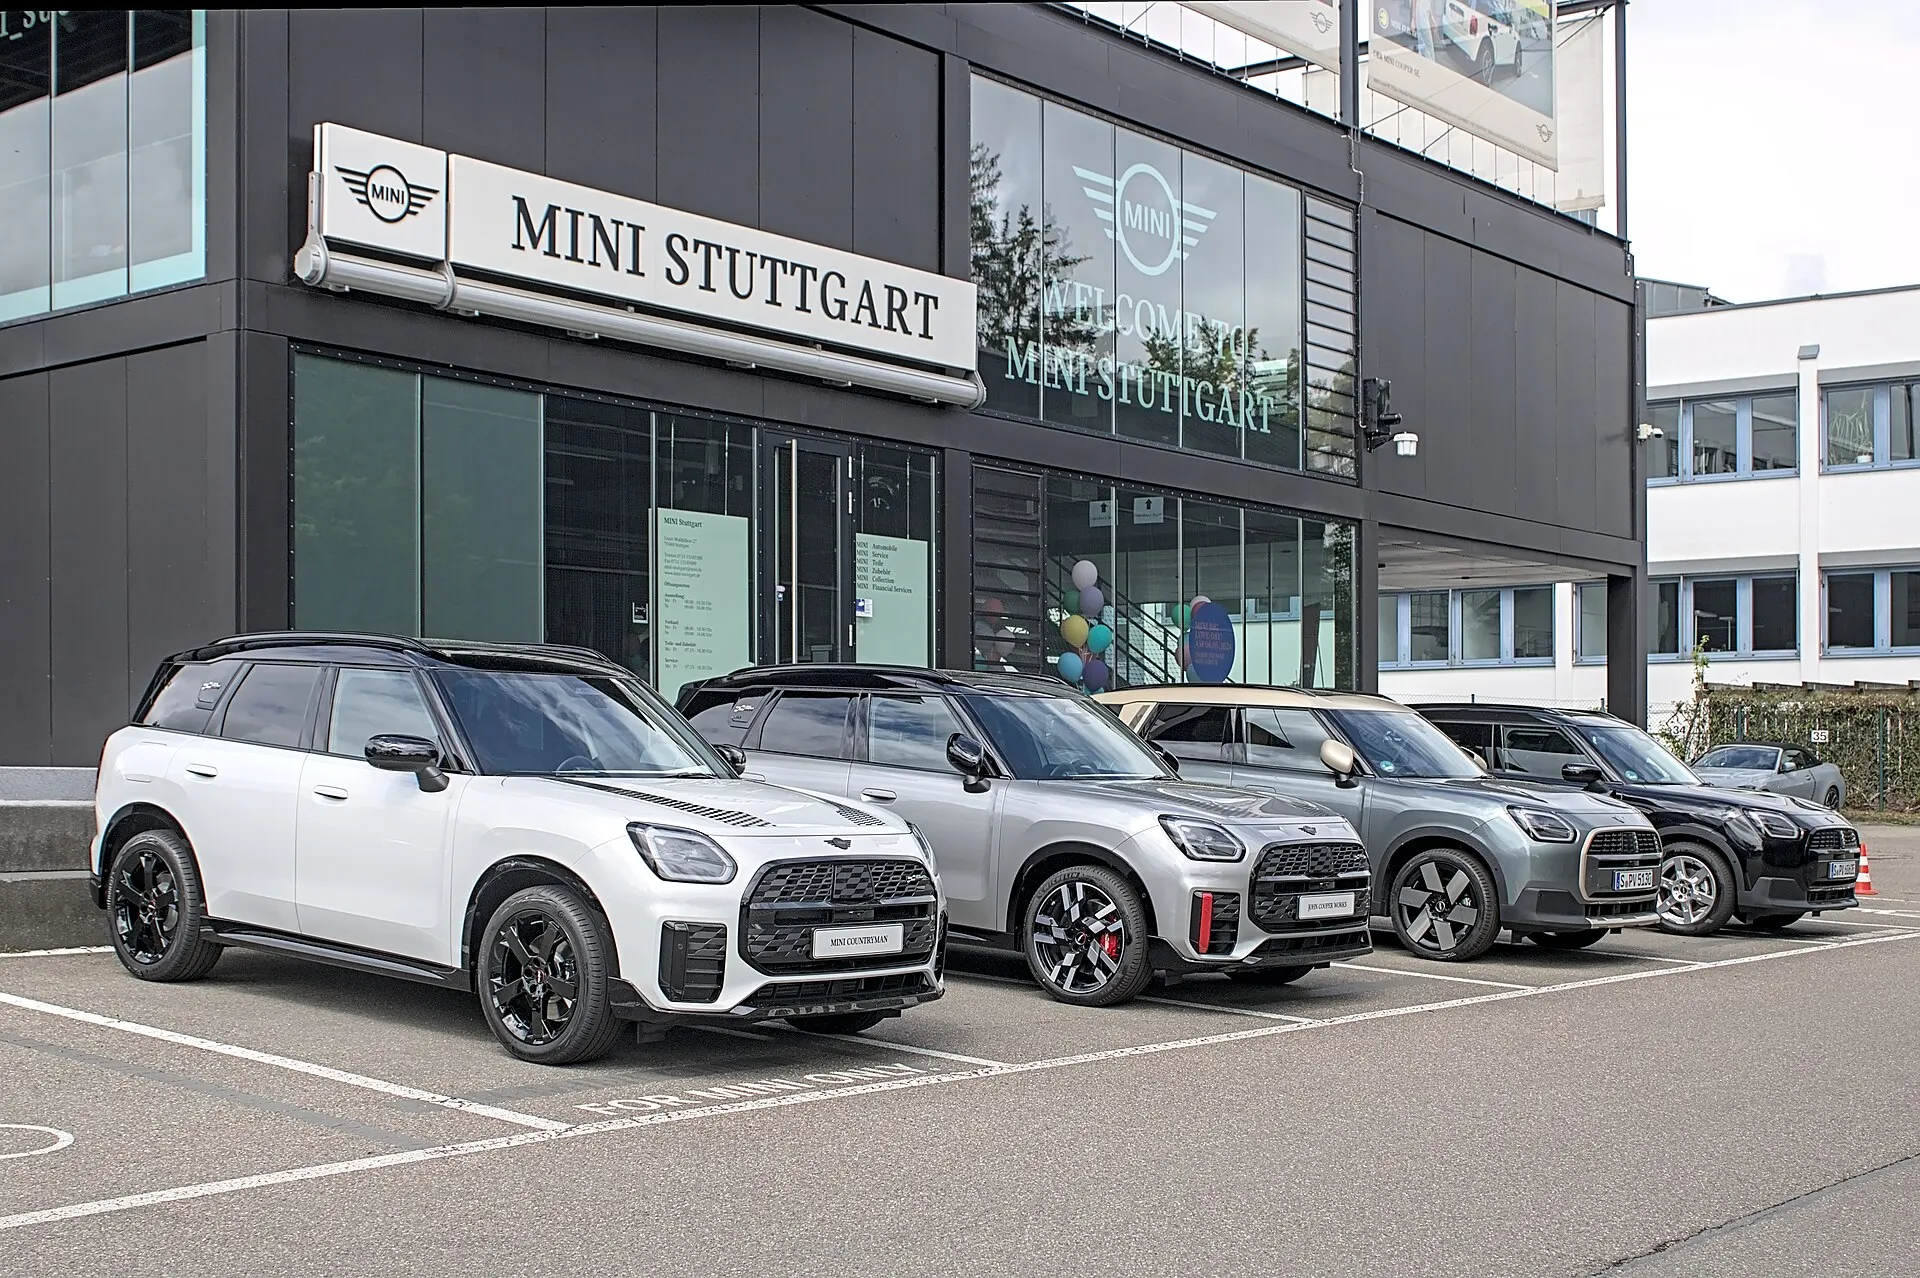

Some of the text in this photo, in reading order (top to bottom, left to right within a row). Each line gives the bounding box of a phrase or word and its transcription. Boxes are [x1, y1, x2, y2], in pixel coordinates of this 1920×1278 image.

[371, 183, 405, 205] MINI
[1124, 199, 1170, 239] MINI
[511, 195, 939, 340] MINI STUTTGART
[1042, 278, 1250, 364] WELCOME TO
[1005, 335, 1275, 434] MINI STUTTGART
[664, 516, 703, 529] MINI Stuttgart
[872, 543, 898, 552] Automobile
[872, 551, 889, 559] Service
[872, 559, 884, 567] Teile
[872, 567, 891, 575] Zubehör
[872, 576, 895, 584] Collection
[872, 583, 893, 592] Financial
[893, 586, 913, 594] Services
[1672, 725, 1686, 735] 34
[1812, 731, 1828, 741] 35
[1620, 874, 1625, 888] S
[1307, 901, 1348, 912] JOHN COOPER WORKS
[830, 935, 889, 947] MINI COUNTRYMAN
[572, 1062, 928, 1115] FOR MINI ONLY
